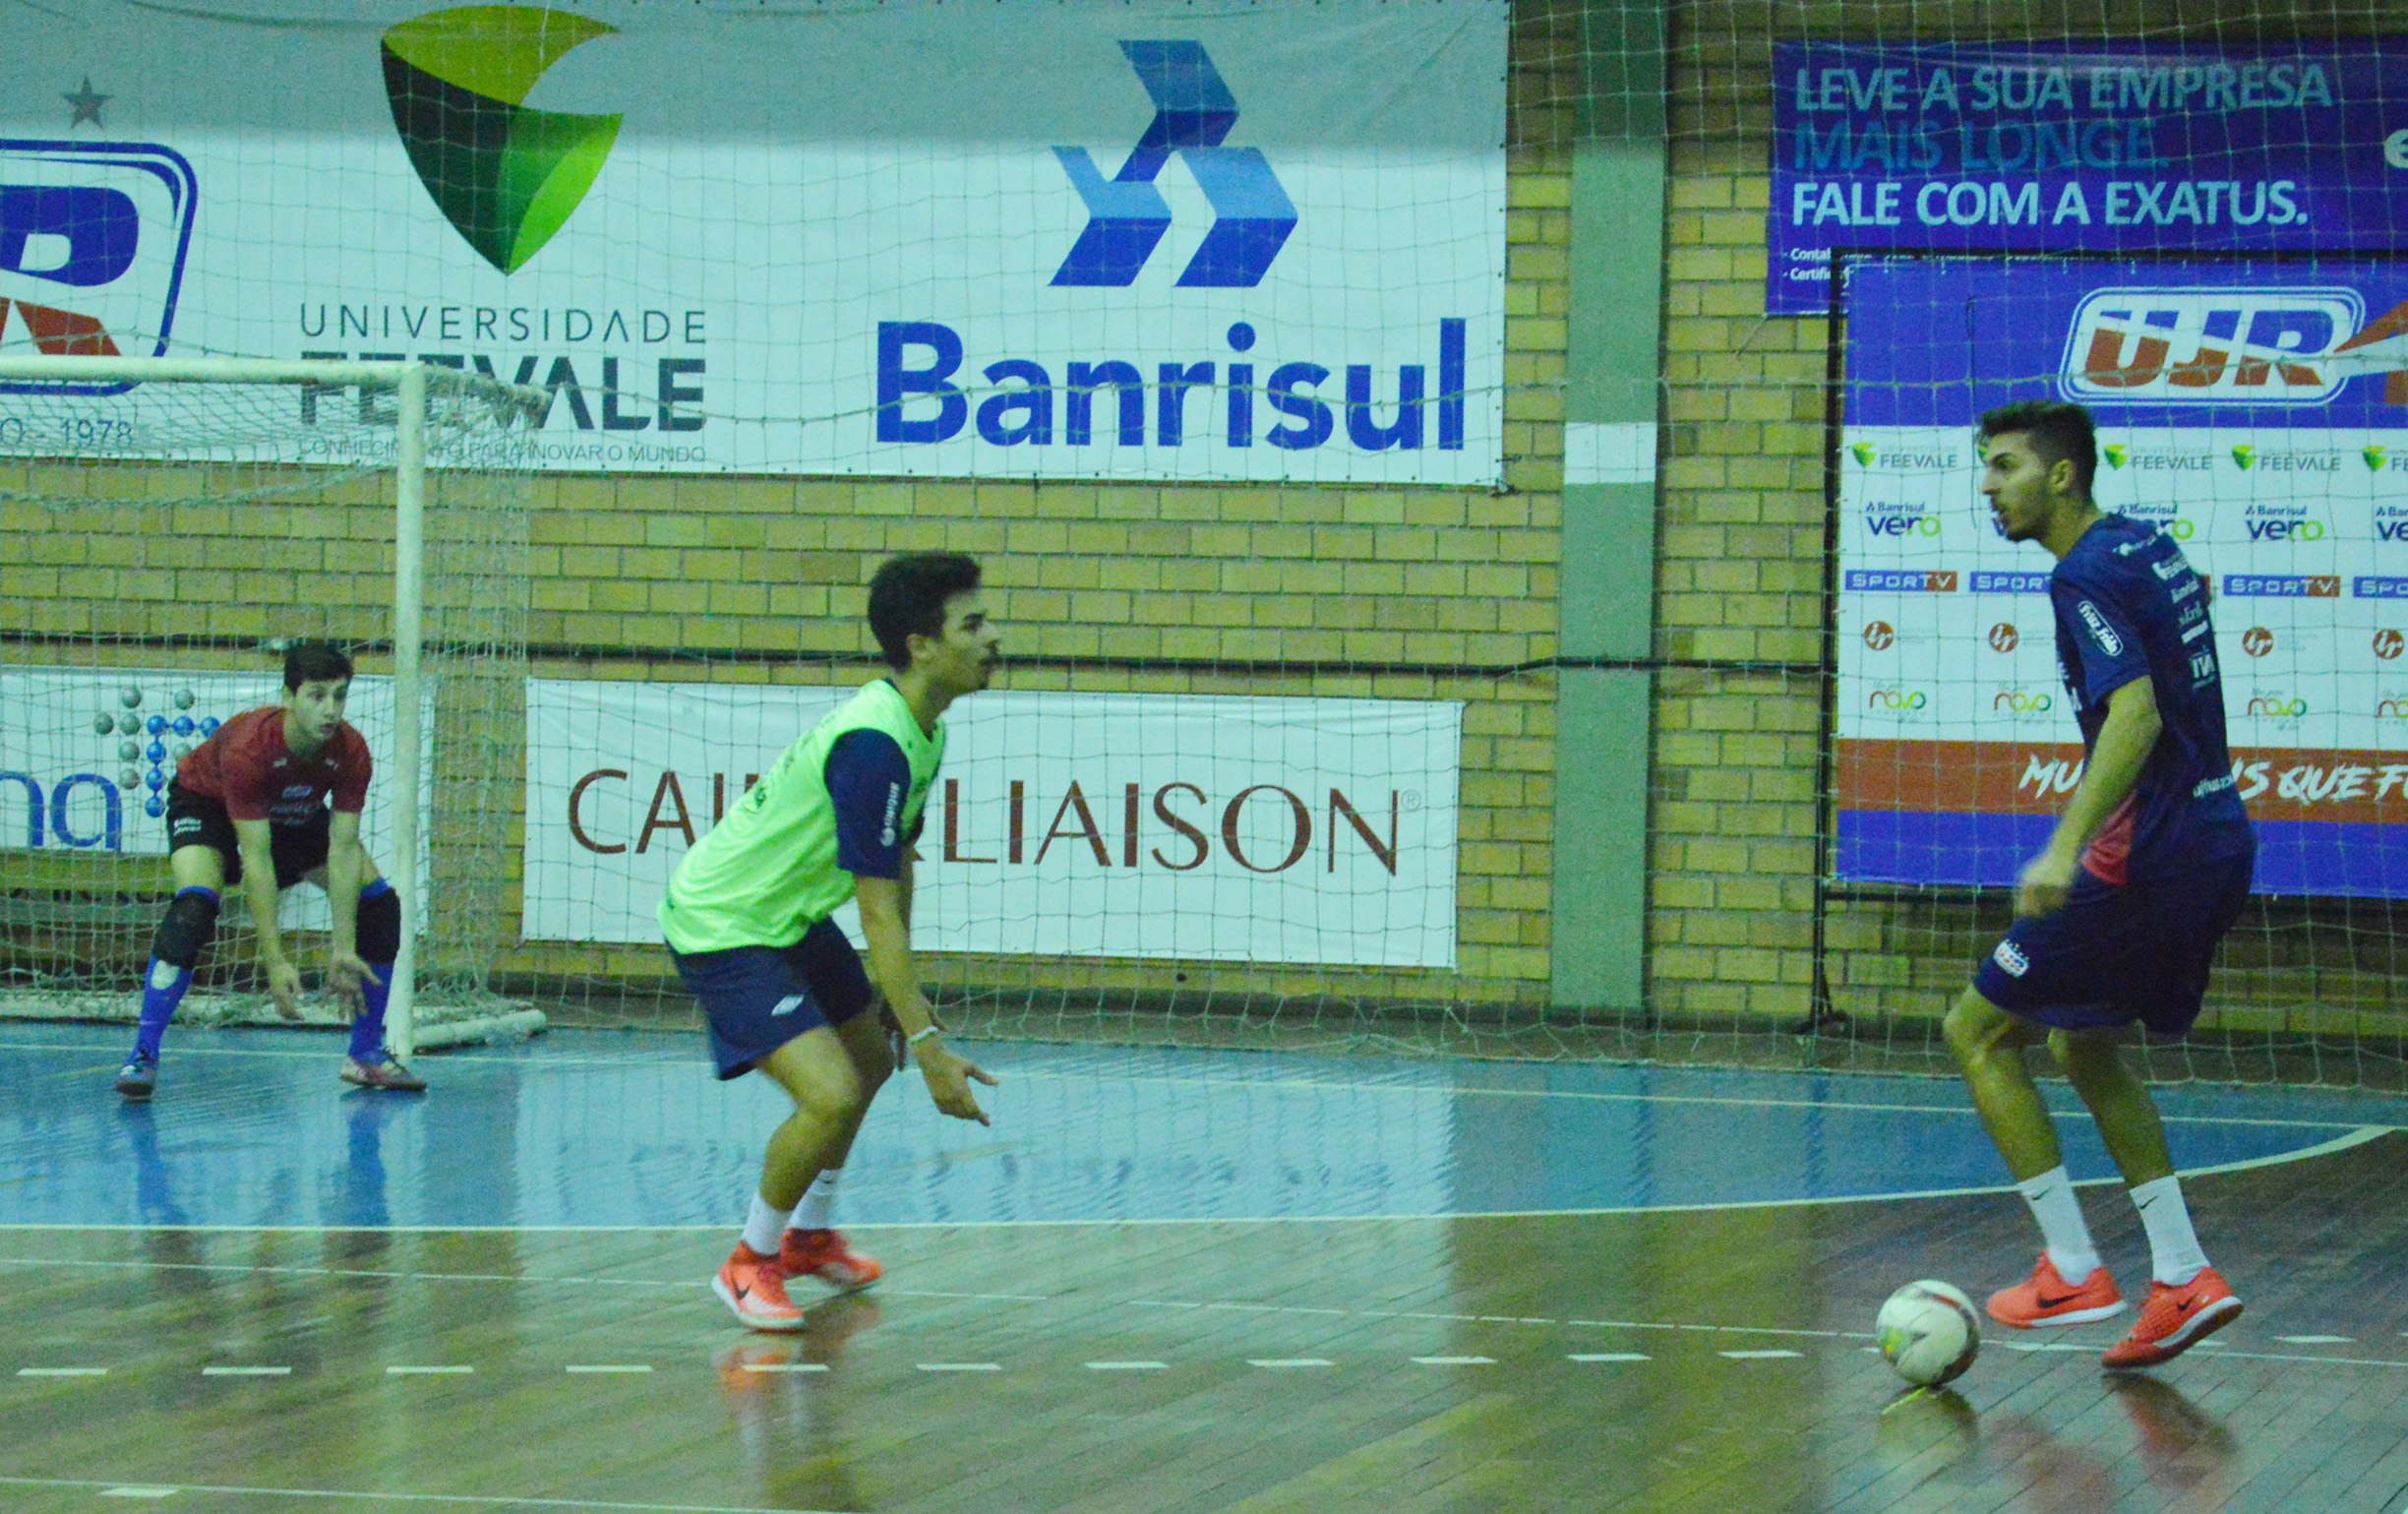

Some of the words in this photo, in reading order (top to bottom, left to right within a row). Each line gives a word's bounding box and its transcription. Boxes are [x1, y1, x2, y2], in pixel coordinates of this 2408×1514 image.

[1796, 68, 1909, 111] LEVE
[1921, 68, 1960, 110] A
[1971, 66, 2074, 110] SUA
[2088, 63, 2333, 110] EMPRESA
[1794, 119, 1943, 170] MAIS
[1792, 181, 1902, 226] FALE
[1916, 181, 2040, 226] COM
[2052, 181, 2091, 226] A
[2104, 180, 2309, 226] EXATUS.
[301, 302, 706, 344] UNIVERSIDADE
[2084, 309, 2334, 388] UJR
[876, 317, 1467, 452] Banrisul
[629, 446, 706, 463] MUNDO
[1880, 454, 1958, 468] FEEVALE
[2133, 455, 2212, 470] FEEVALE
[2260, 456, 2341, 471] FEEVALE
[1866, 515, 1942, 537] vero
[2246, 519, 2324, 541] vero
[1852, 573, 1953, 588] SPORTV
[1976, 575, 2052, 590] SPOR
[2231, 577, 2334, 594] SPORTV
[2277, 762, 2375, 806] QUE
[943, 778, 1398, 877] LIAISON
